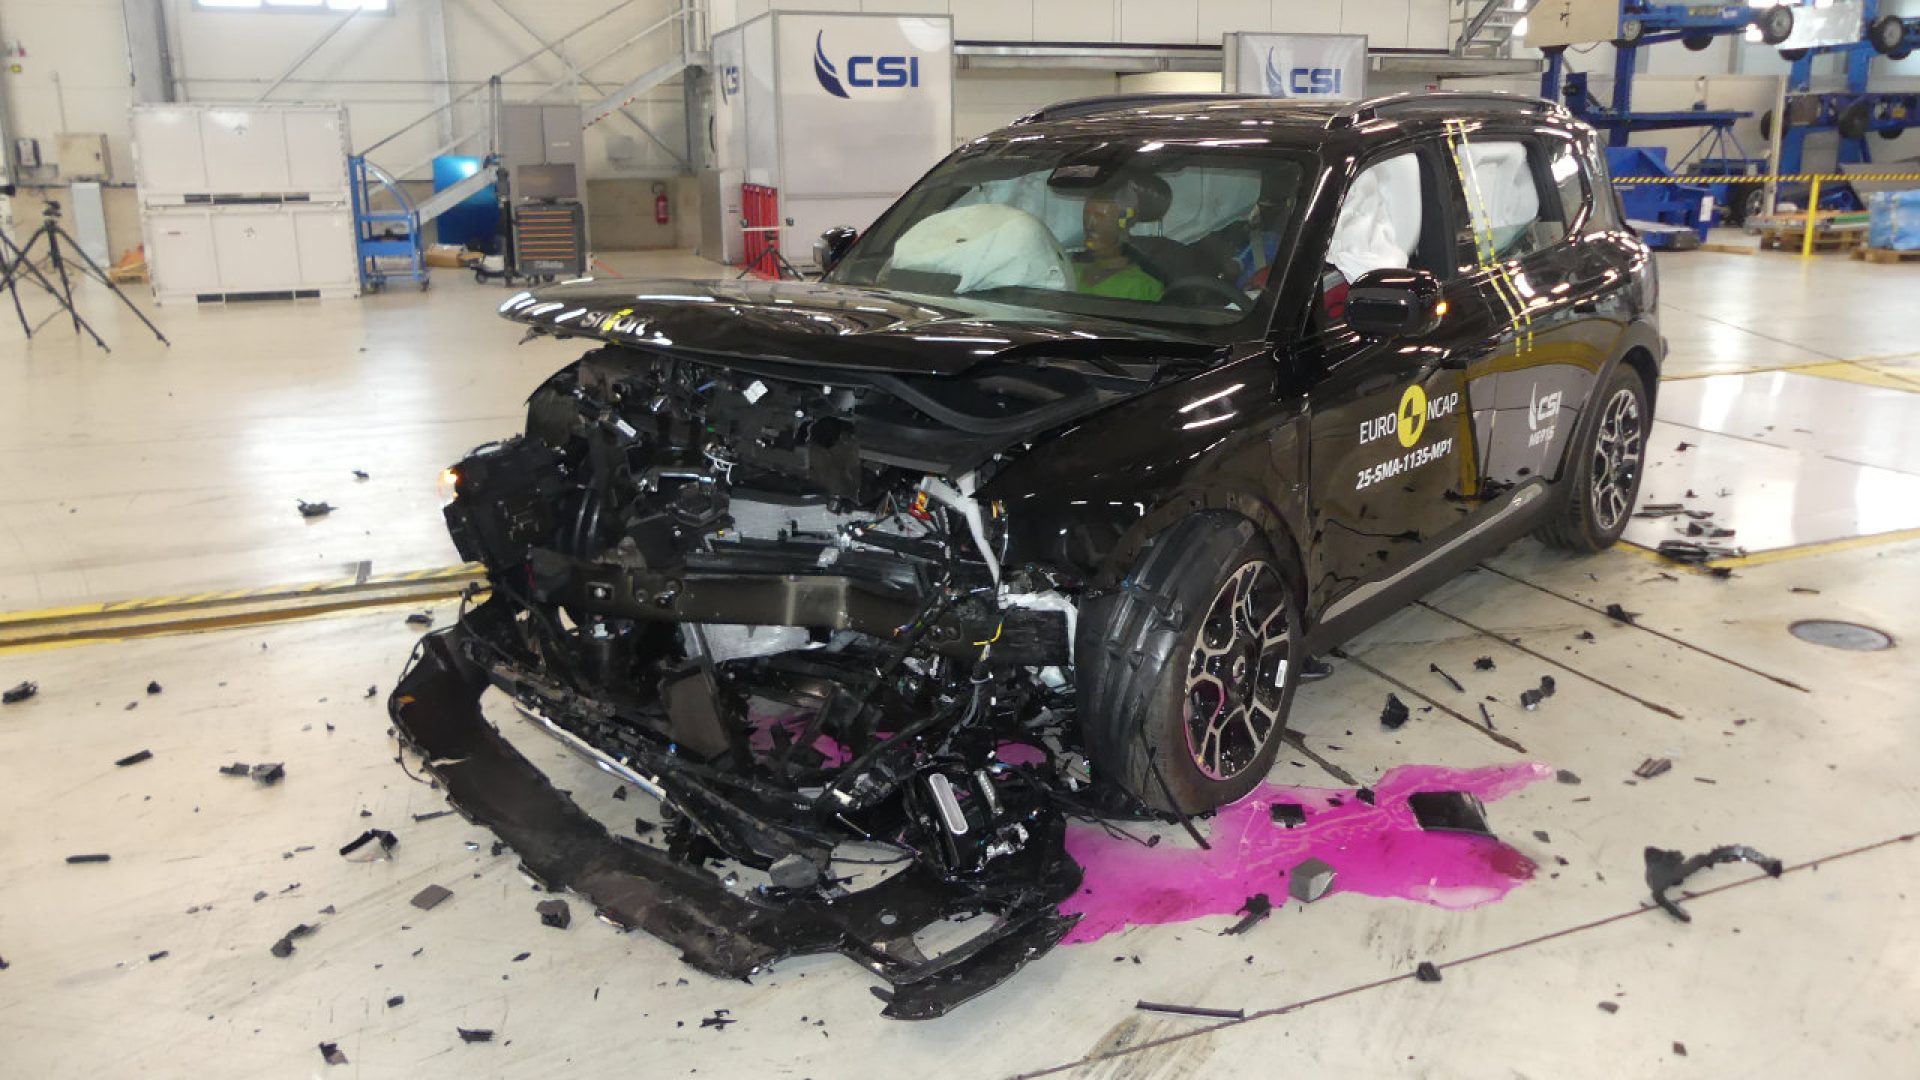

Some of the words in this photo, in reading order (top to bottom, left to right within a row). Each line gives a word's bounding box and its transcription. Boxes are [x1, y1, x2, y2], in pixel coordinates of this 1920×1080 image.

[847, 56, 919, 87] CSI
[1289, 68, 1341, 94] CSI
[1360, 412, 1397, 444] EURO
[1427, 393, 1459, 420] NCAP
[1537, 390, 1562, 421] CSI
[1356, 438, 1453, 490] 25-SMA-1135-MP1
